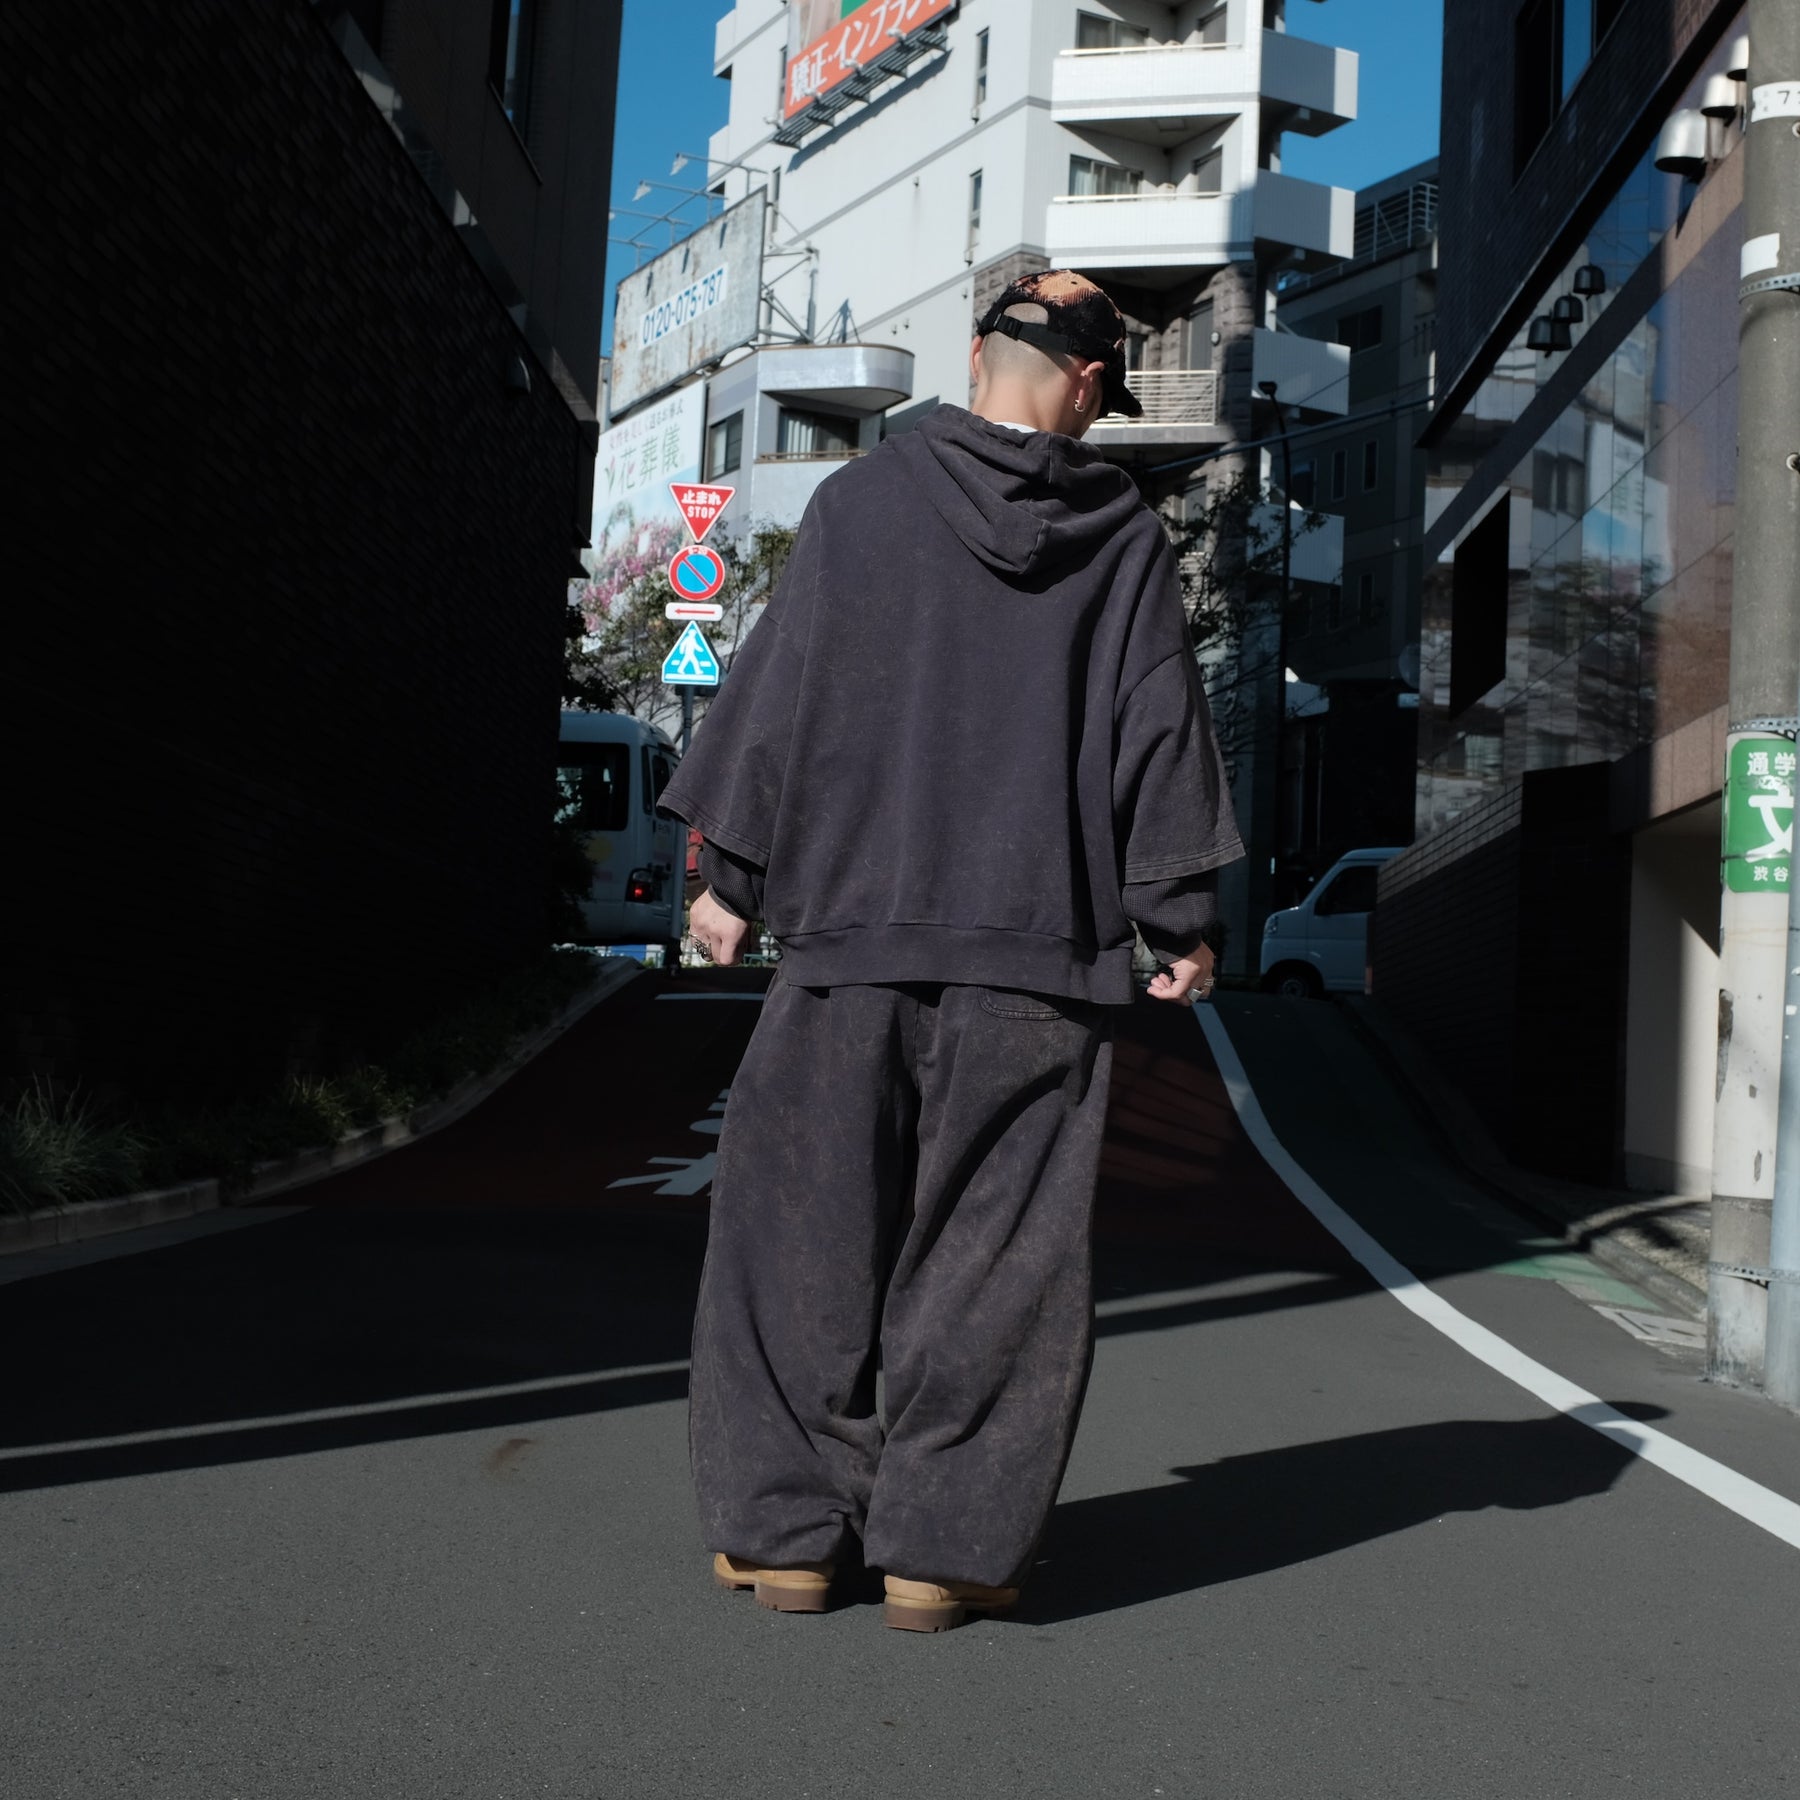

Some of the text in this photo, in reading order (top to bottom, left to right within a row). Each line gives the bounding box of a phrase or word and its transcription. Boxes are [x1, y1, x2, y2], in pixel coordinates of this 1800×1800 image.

[1777, 90, 1800, 105] 7
[643, 268, 723, 344] 0120-075-787
[619, 423, 681, 495] 花葬儀
[681, 489, 722, 506] 止まれ
[687, 505, 716, 519] STOP
[1753, 866, 1789, 882] 渋谷
